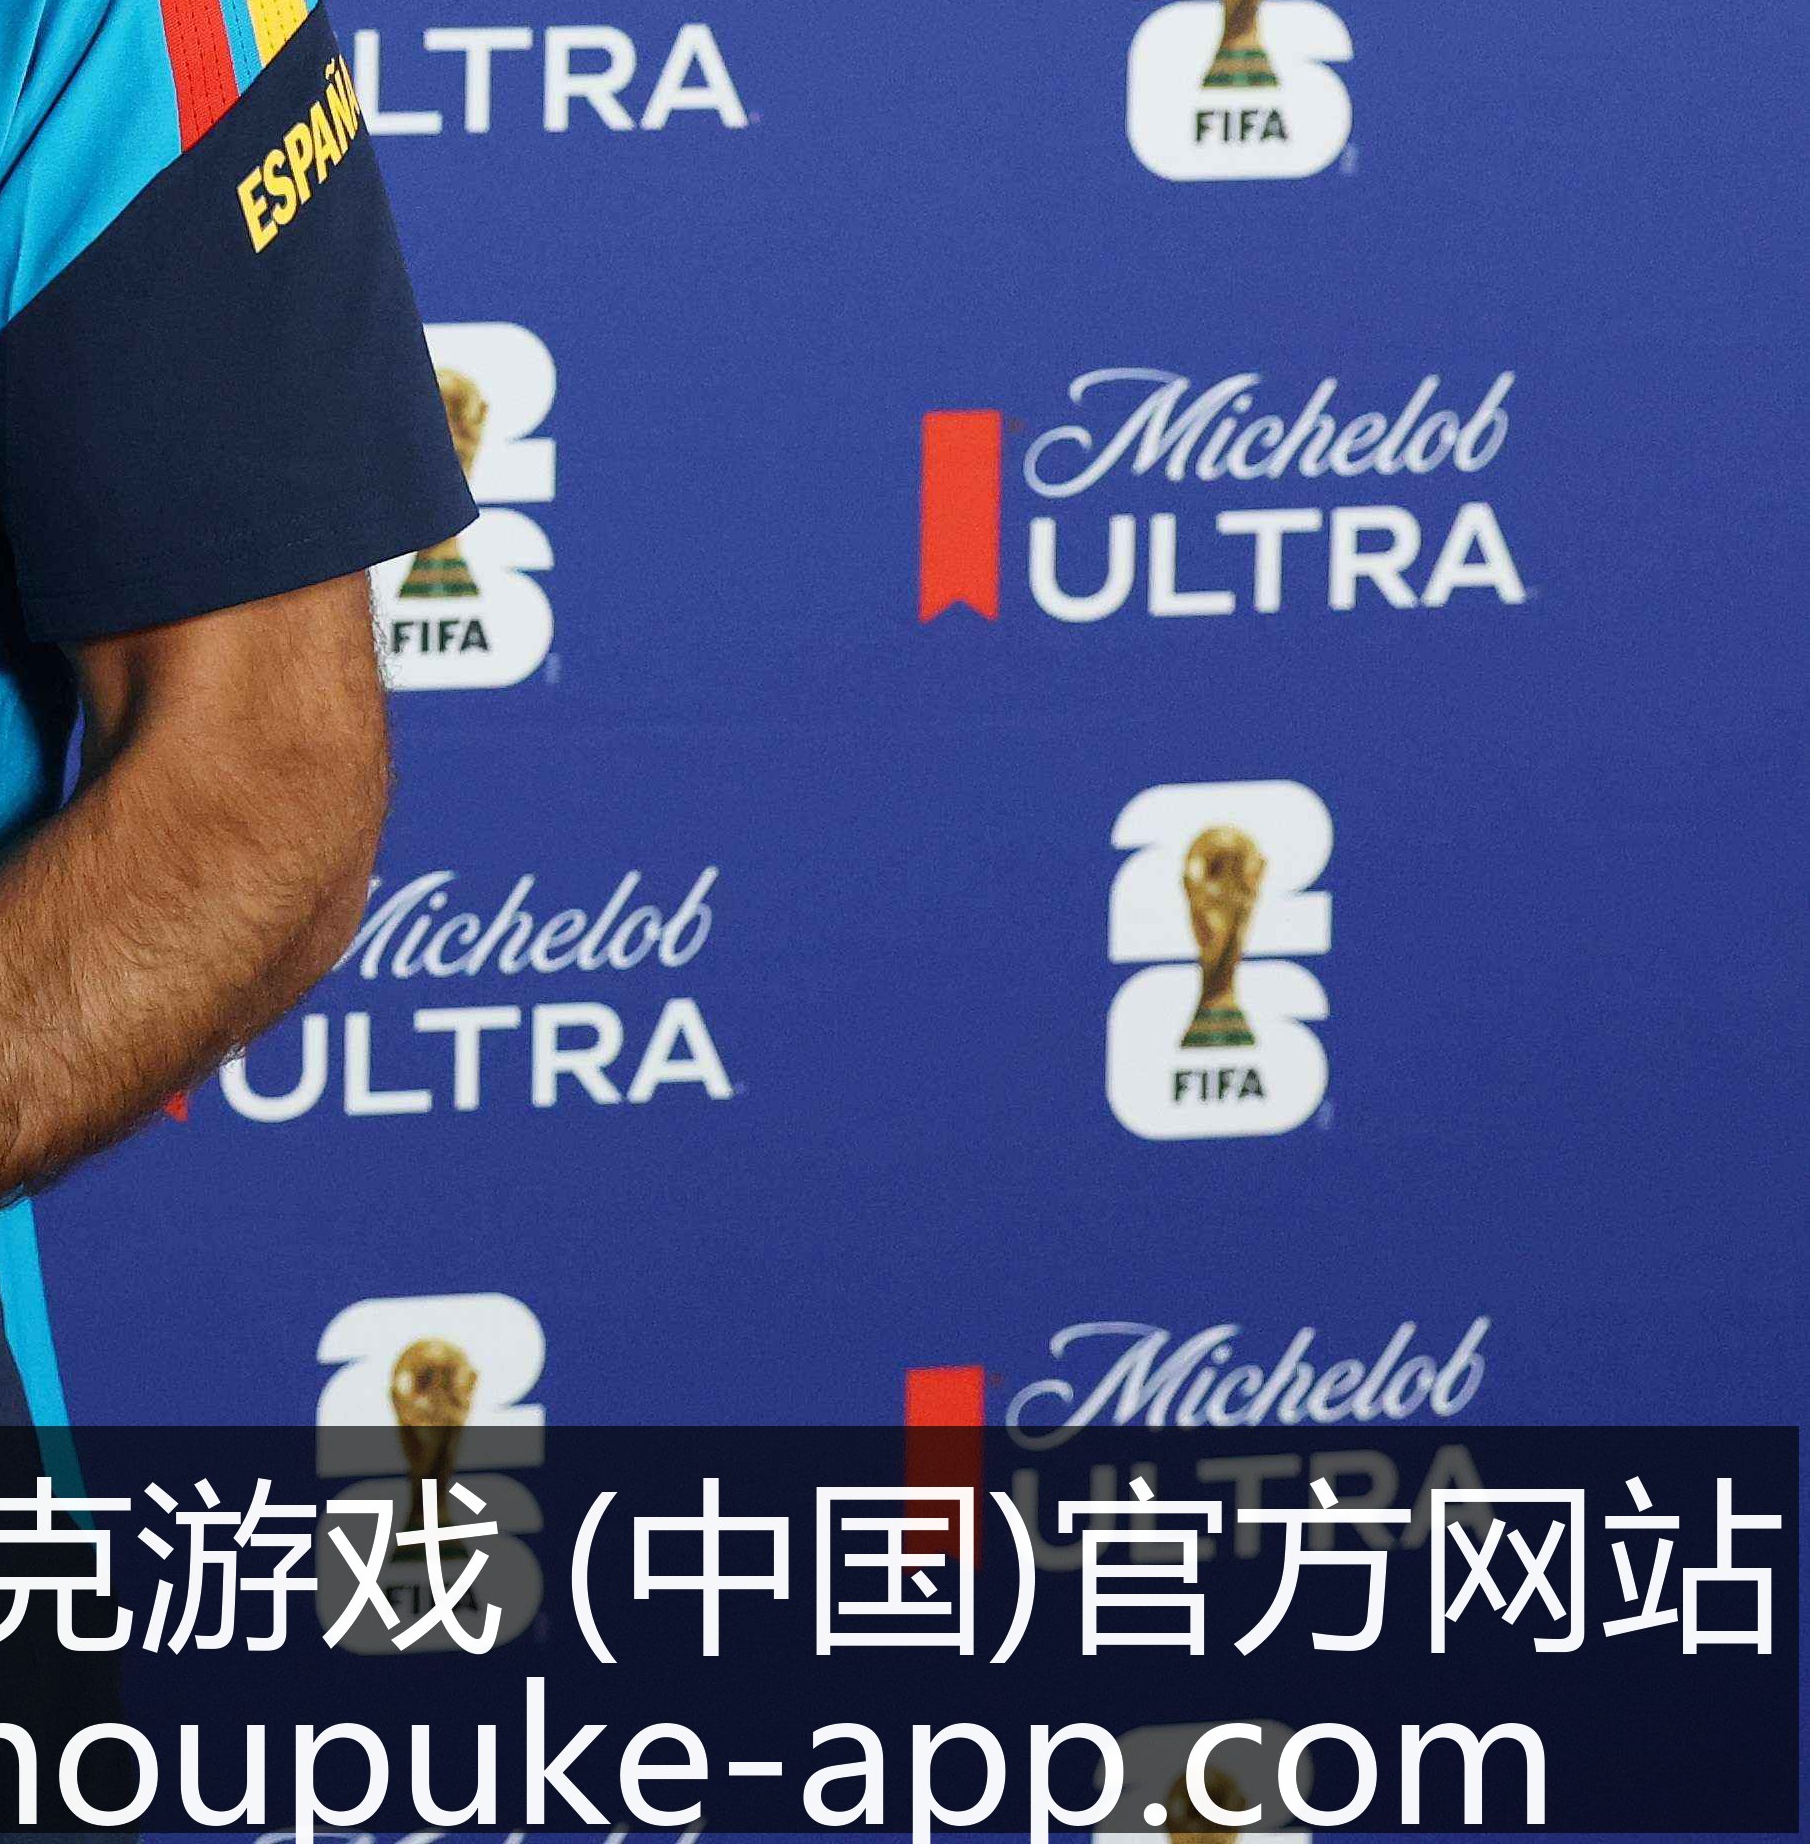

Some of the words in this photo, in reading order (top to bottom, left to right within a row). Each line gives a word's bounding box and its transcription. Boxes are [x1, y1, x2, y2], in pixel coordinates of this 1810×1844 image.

[354, 24, 748, 136] LTRA
[1194, 107, 1289, 144] FIFA
[1025, 368, 1514, 497] Michelob
[1029, 502, 1526, 622] ULTRA
[391, 619, 491, 654] FIFA
[218, 998, 733, 1123] ULTRA
[1172, 1067, 1266, 1103] FIFA
[1006, 1317, 1489, 1449] Michelob
